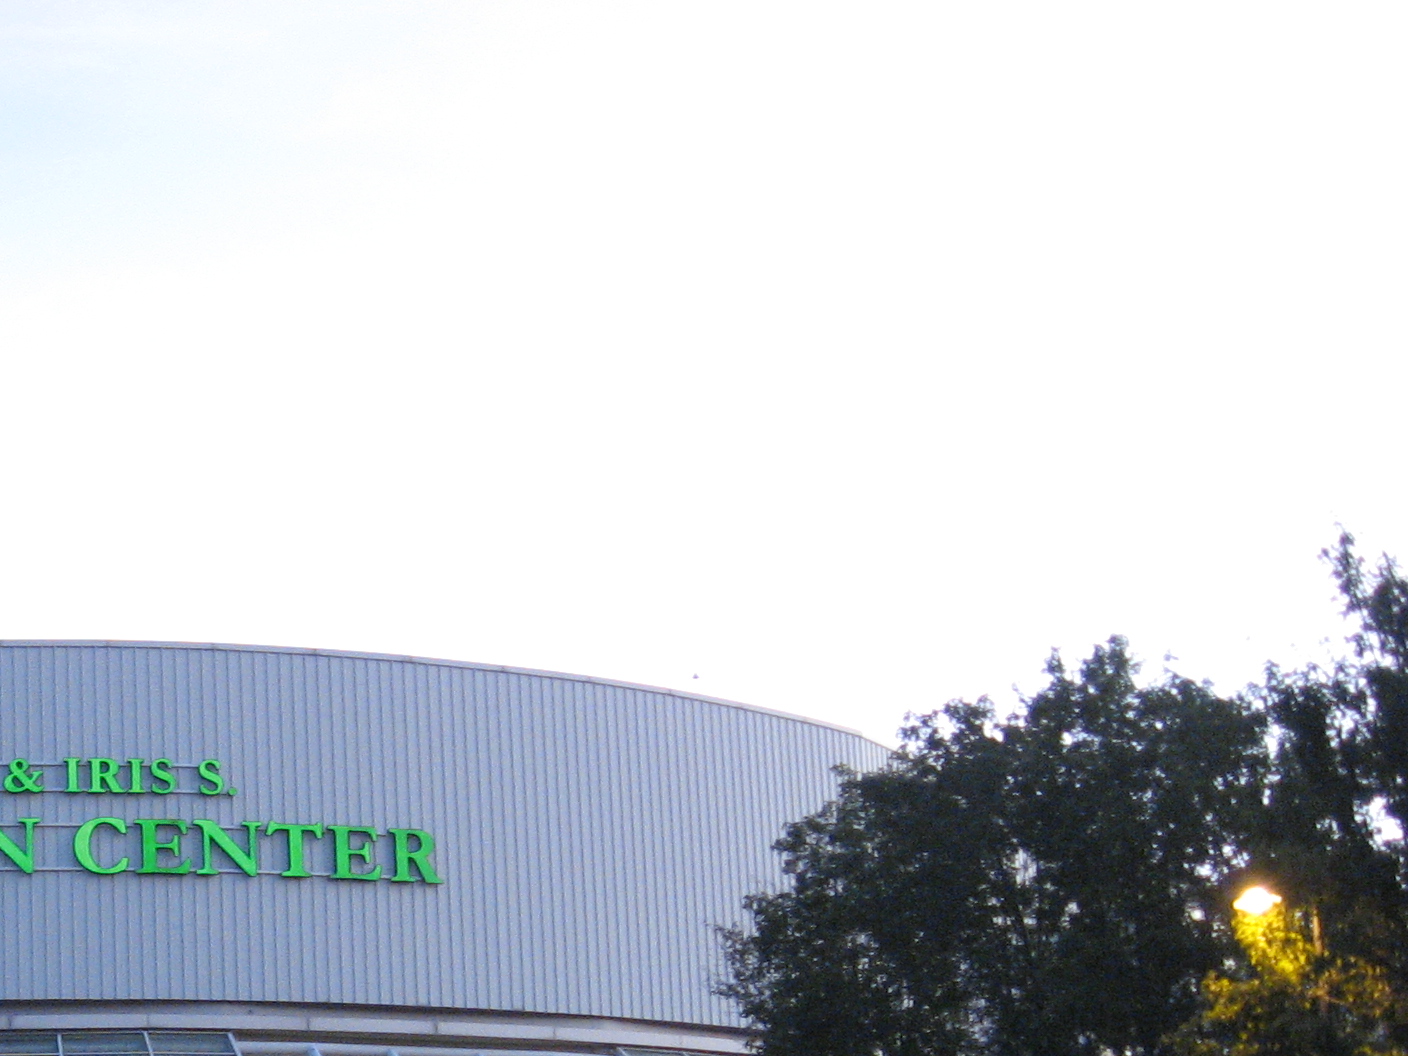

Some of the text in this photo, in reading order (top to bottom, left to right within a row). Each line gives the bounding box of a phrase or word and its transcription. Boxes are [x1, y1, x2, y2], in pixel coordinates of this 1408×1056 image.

[3, 757, 45, 794] &
[64, 757, 177, 794] IRIS
[197, 758, 238, 797] S.
[73, 817, 444, 884] CENTER
